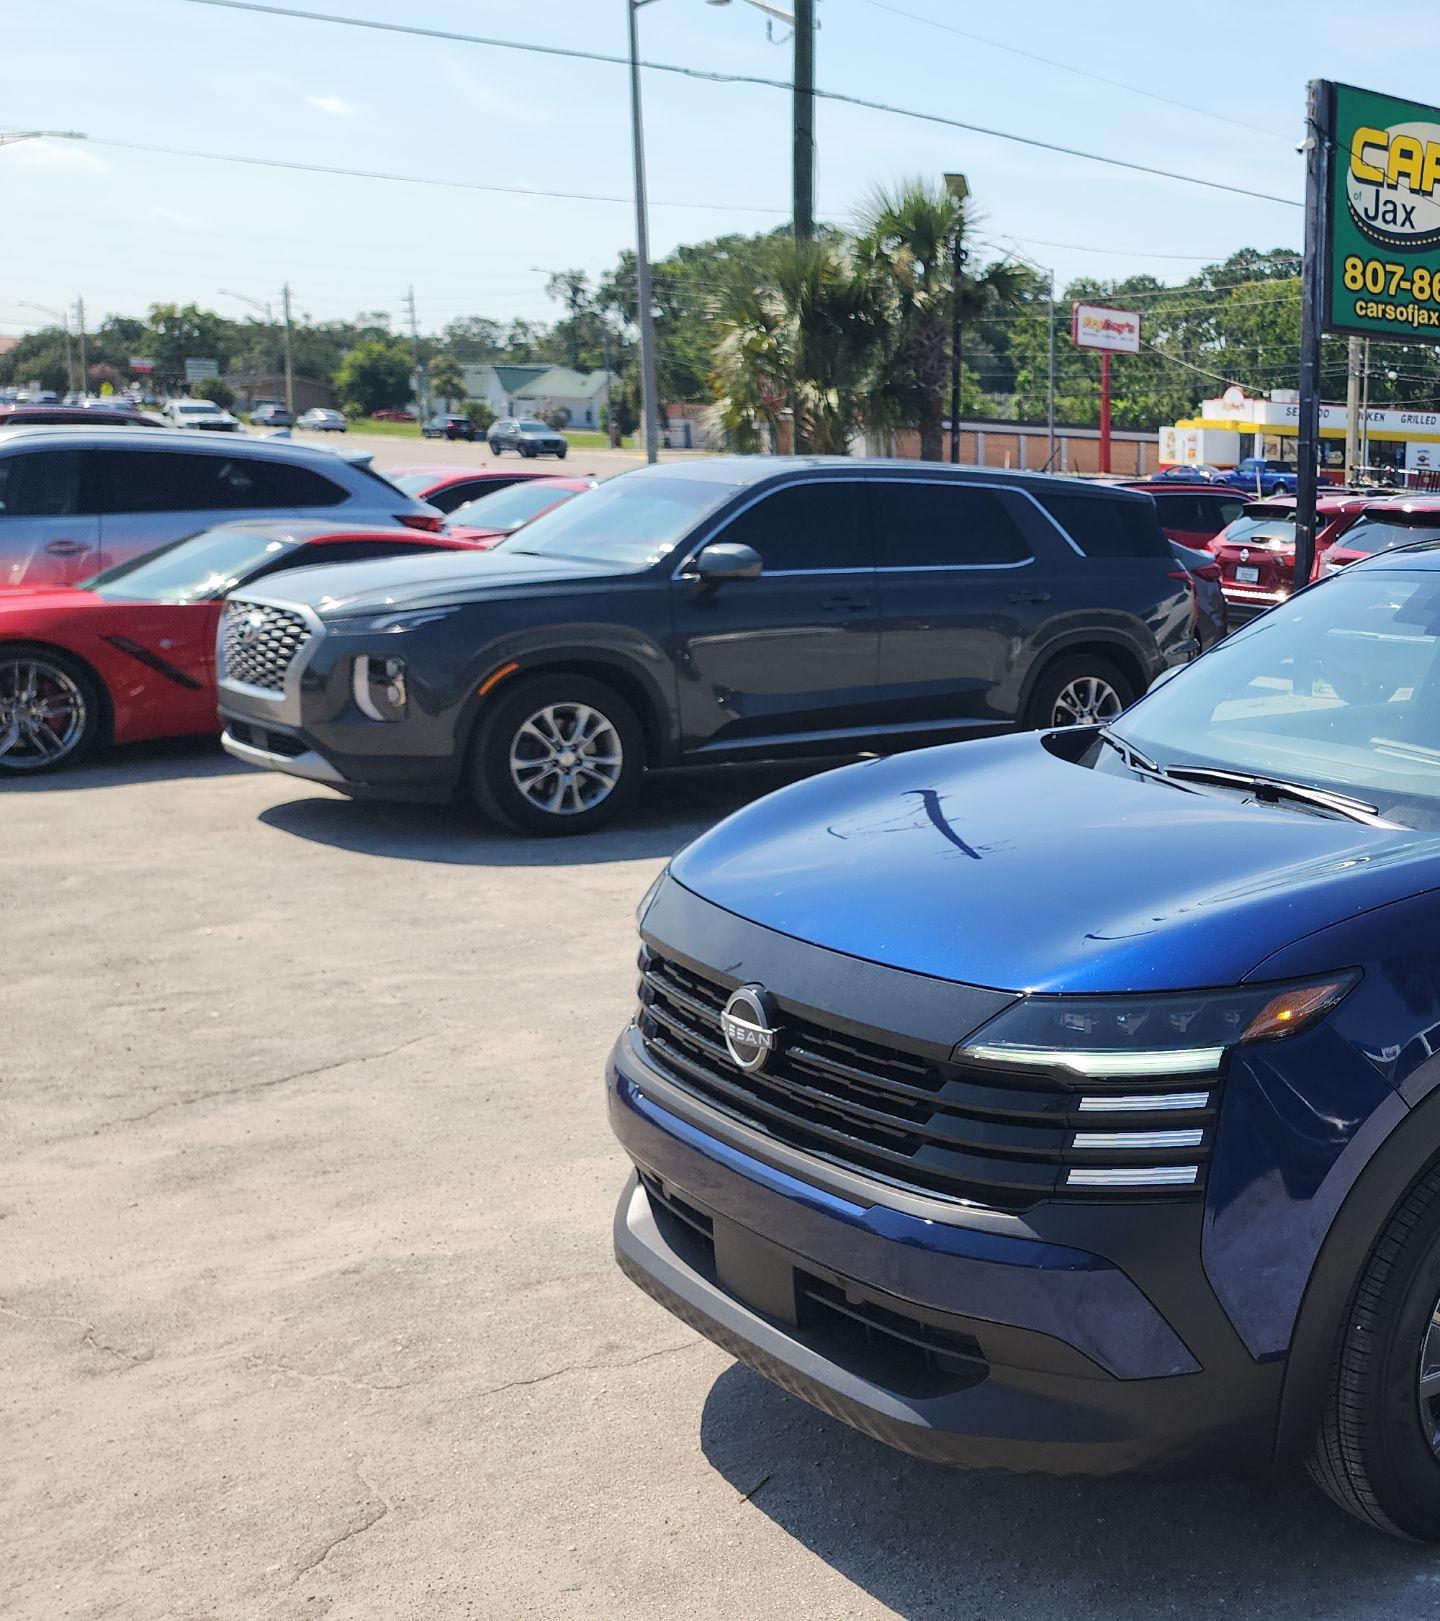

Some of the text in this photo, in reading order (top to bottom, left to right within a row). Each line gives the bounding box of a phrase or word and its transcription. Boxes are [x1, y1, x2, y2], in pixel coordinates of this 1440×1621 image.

[1353, 188, 1416, 230] of Jax
[1285, 406, 1330, 418] SEOD
[1401, 414, 1437, 426] GRILLED
